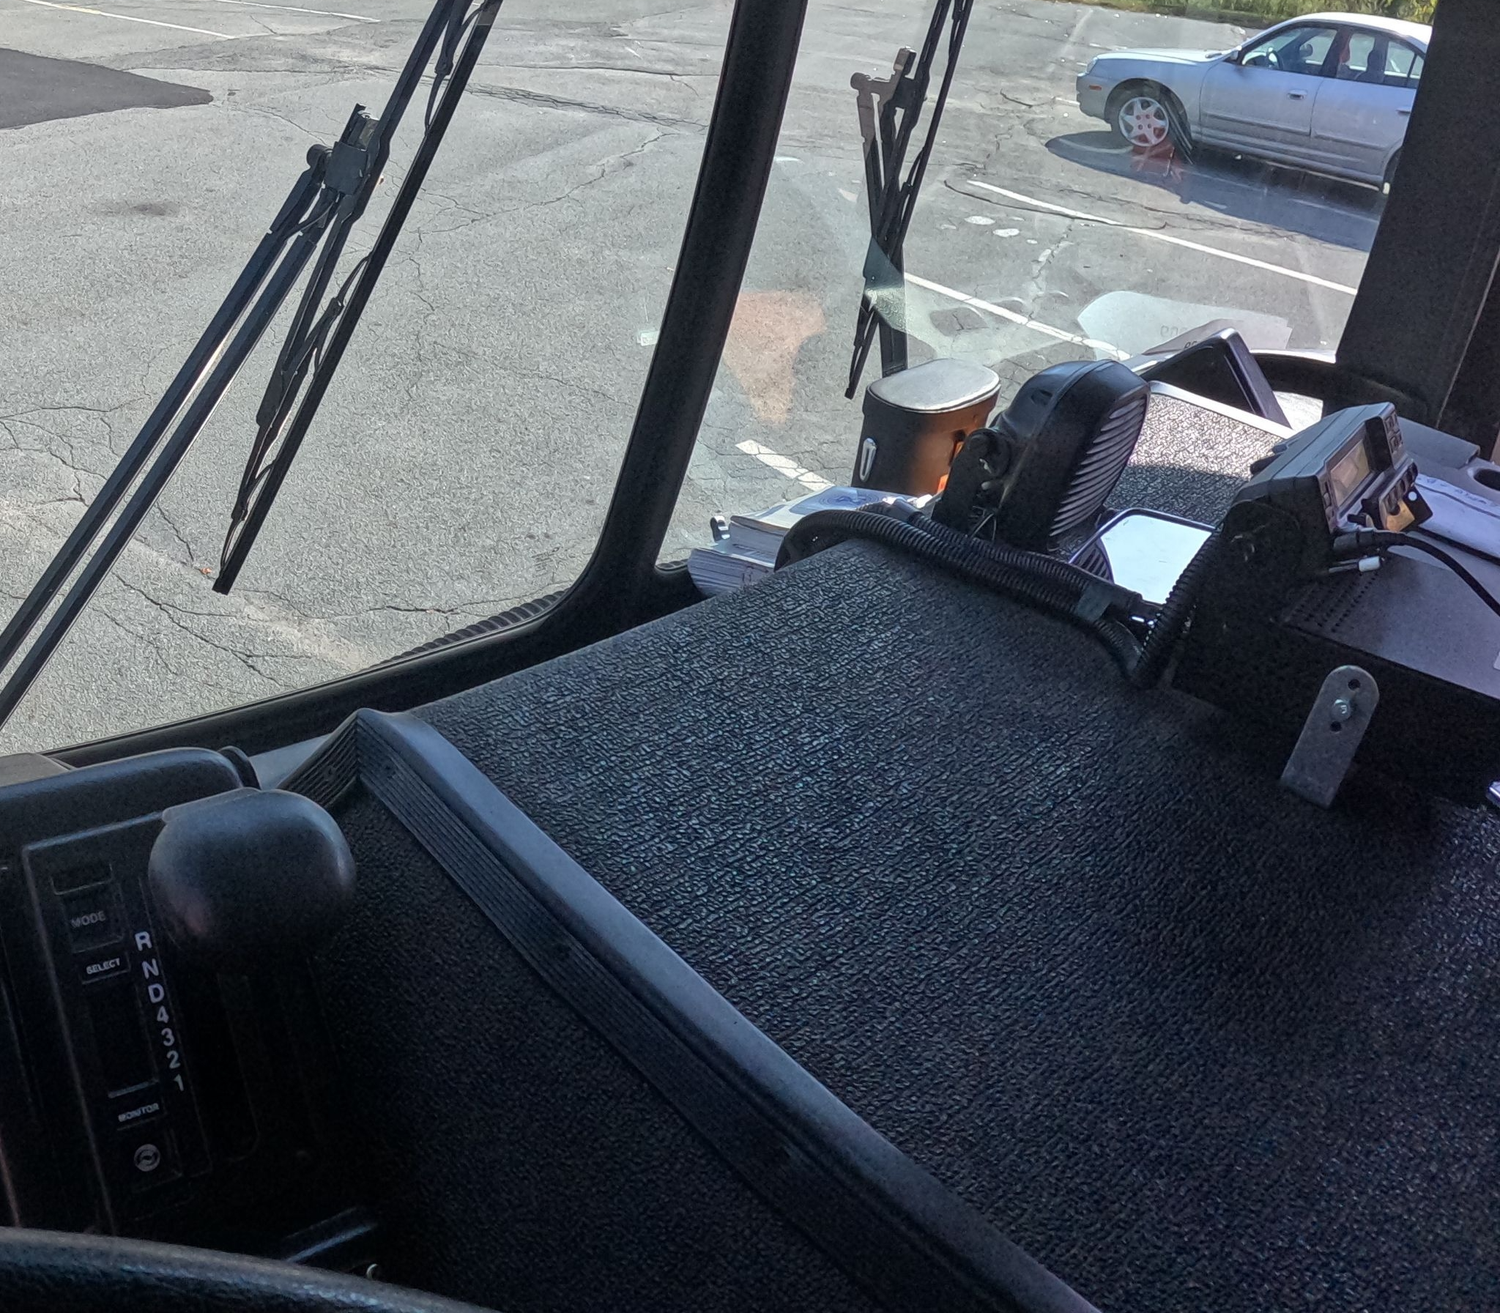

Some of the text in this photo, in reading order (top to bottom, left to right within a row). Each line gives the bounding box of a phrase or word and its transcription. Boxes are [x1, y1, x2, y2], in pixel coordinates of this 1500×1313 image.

[69, 910, 106, 928] MODE
[134, 931, 152, 951] R
[85, 957, 121, 975] SELECT
[141, 958, 159, 979] N
[147, 983, 165, 1004] D
[156, 1005, 169, 1024] 4
[161, 1027, 175, 1047] 3
[166, 1050, 181, 1069] 2
[173, 1074, 184, 1092] 1
